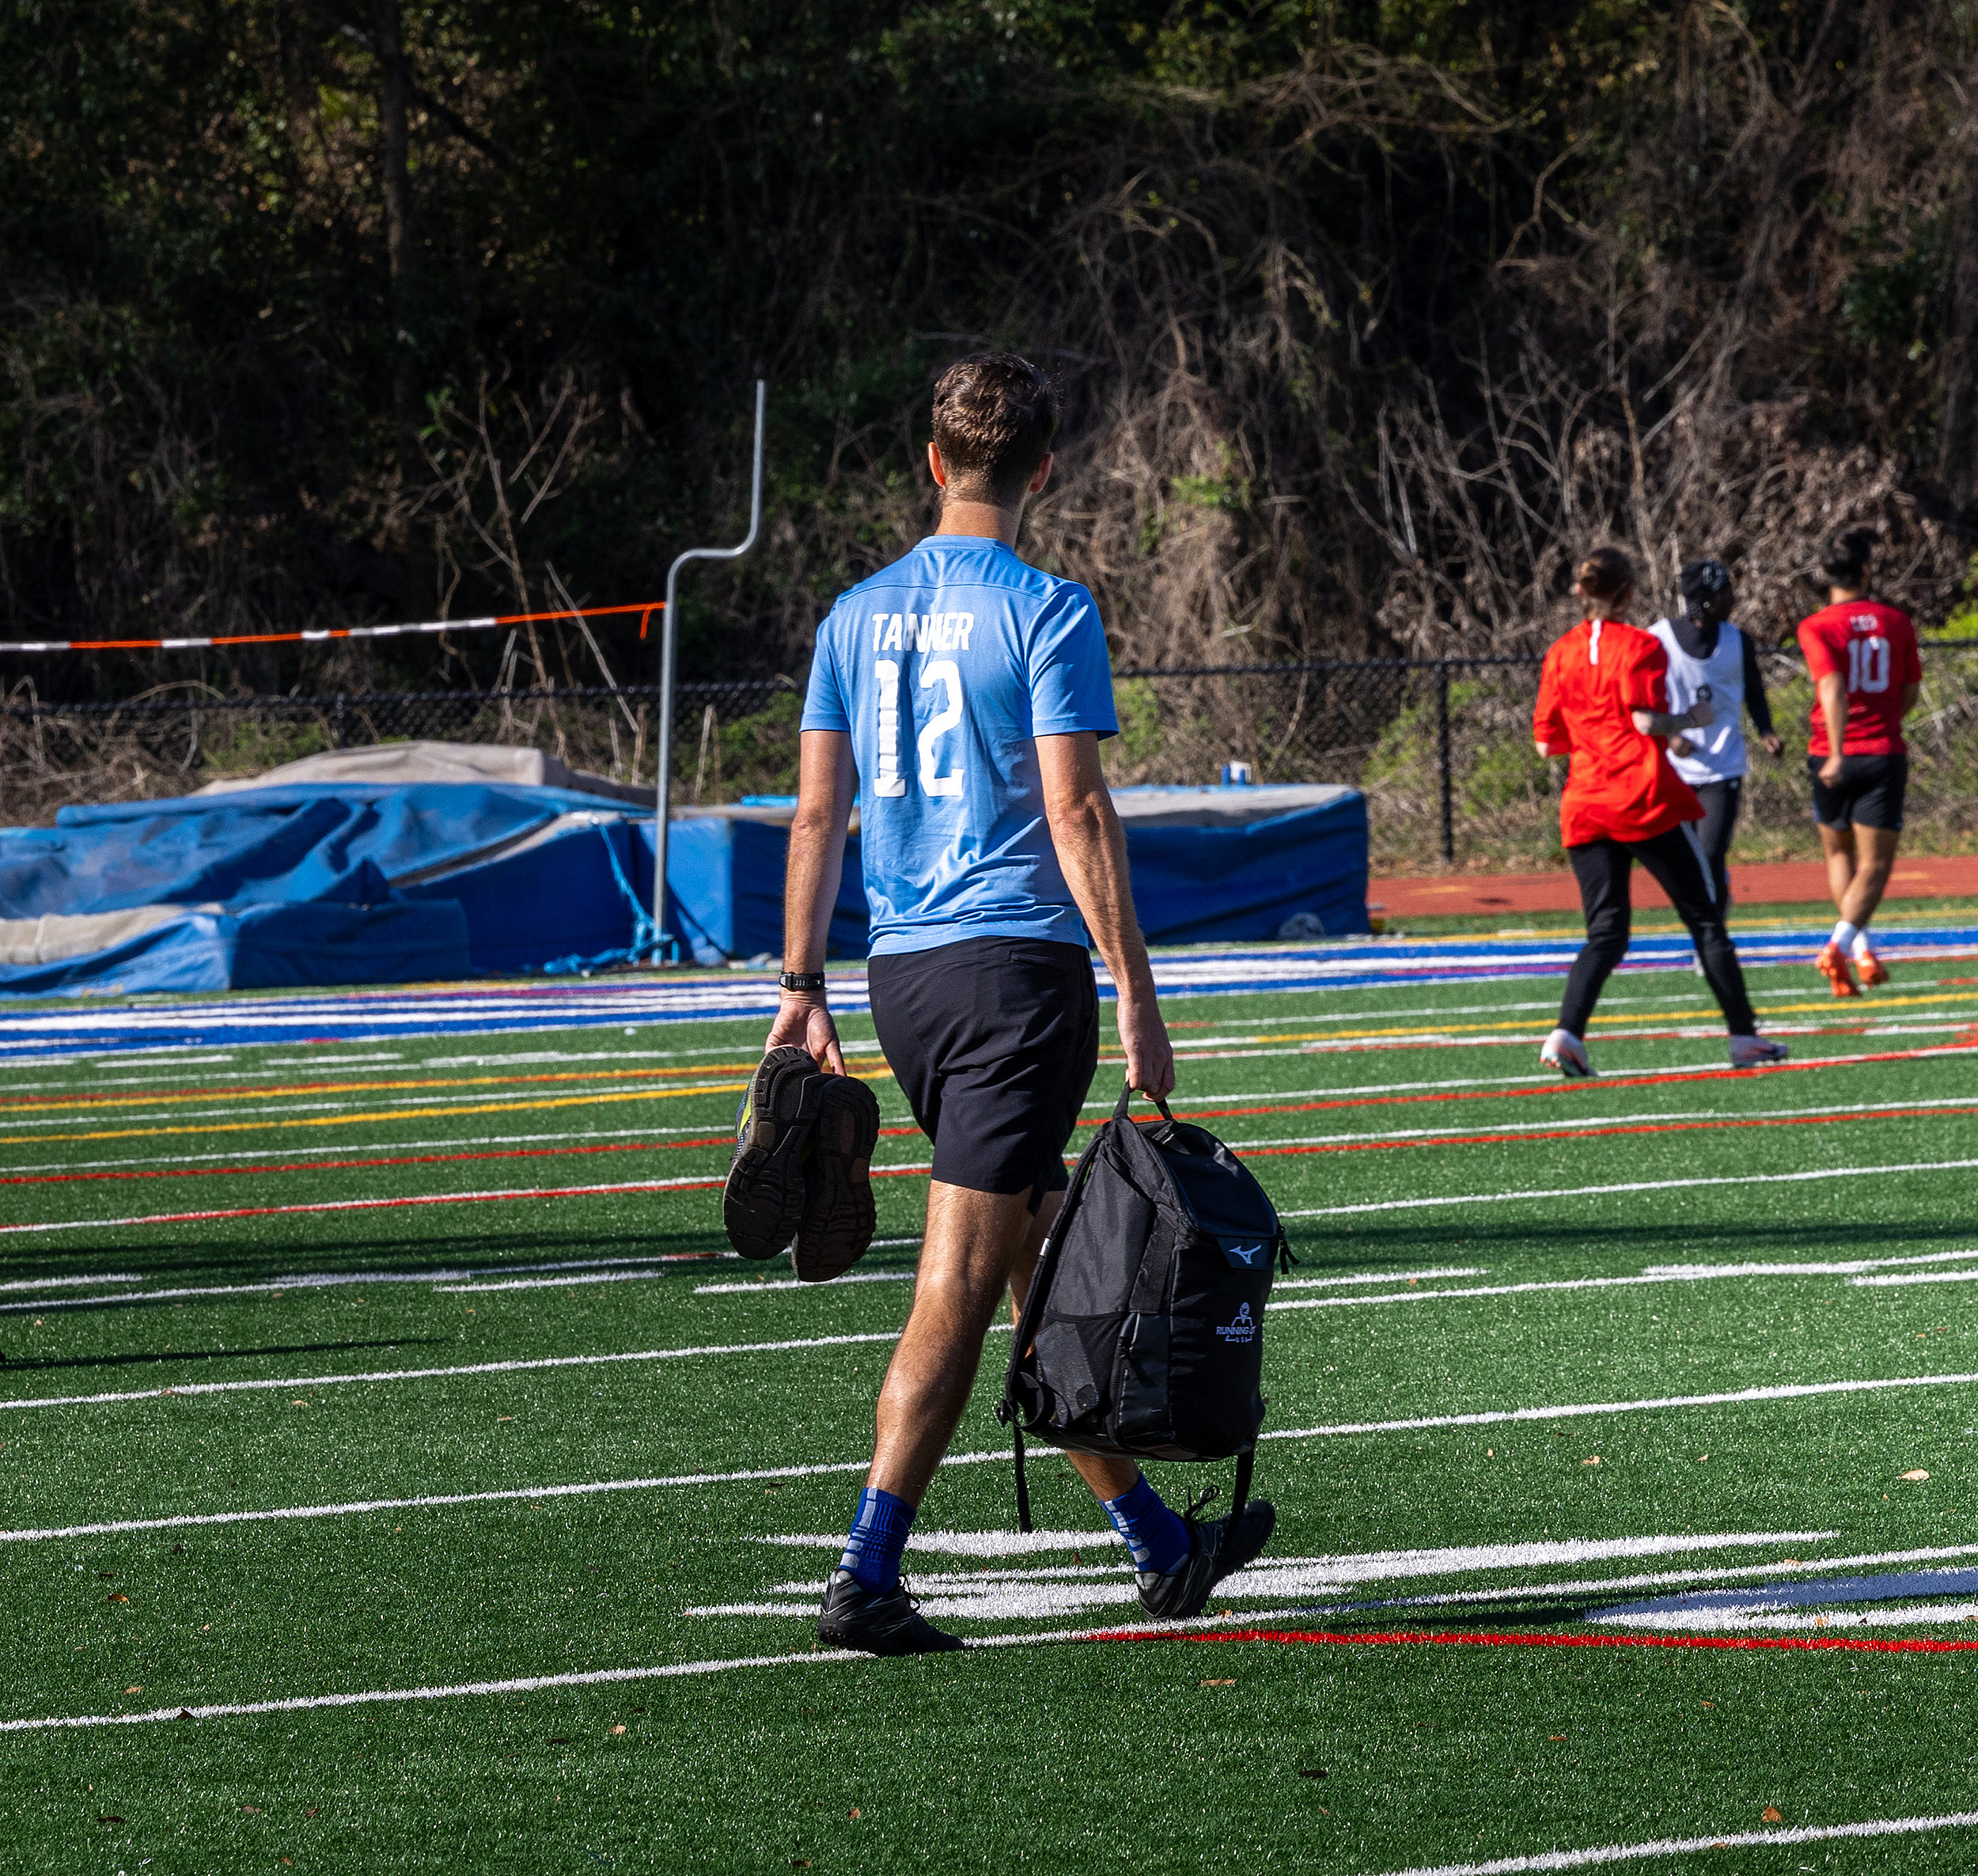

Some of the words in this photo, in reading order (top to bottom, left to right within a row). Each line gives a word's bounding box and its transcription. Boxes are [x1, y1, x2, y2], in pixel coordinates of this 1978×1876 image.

[872, 612, 975, 653] TANNER
[1847, 635, 1890, 693] 10
[873, 659, 964, 798] 12
